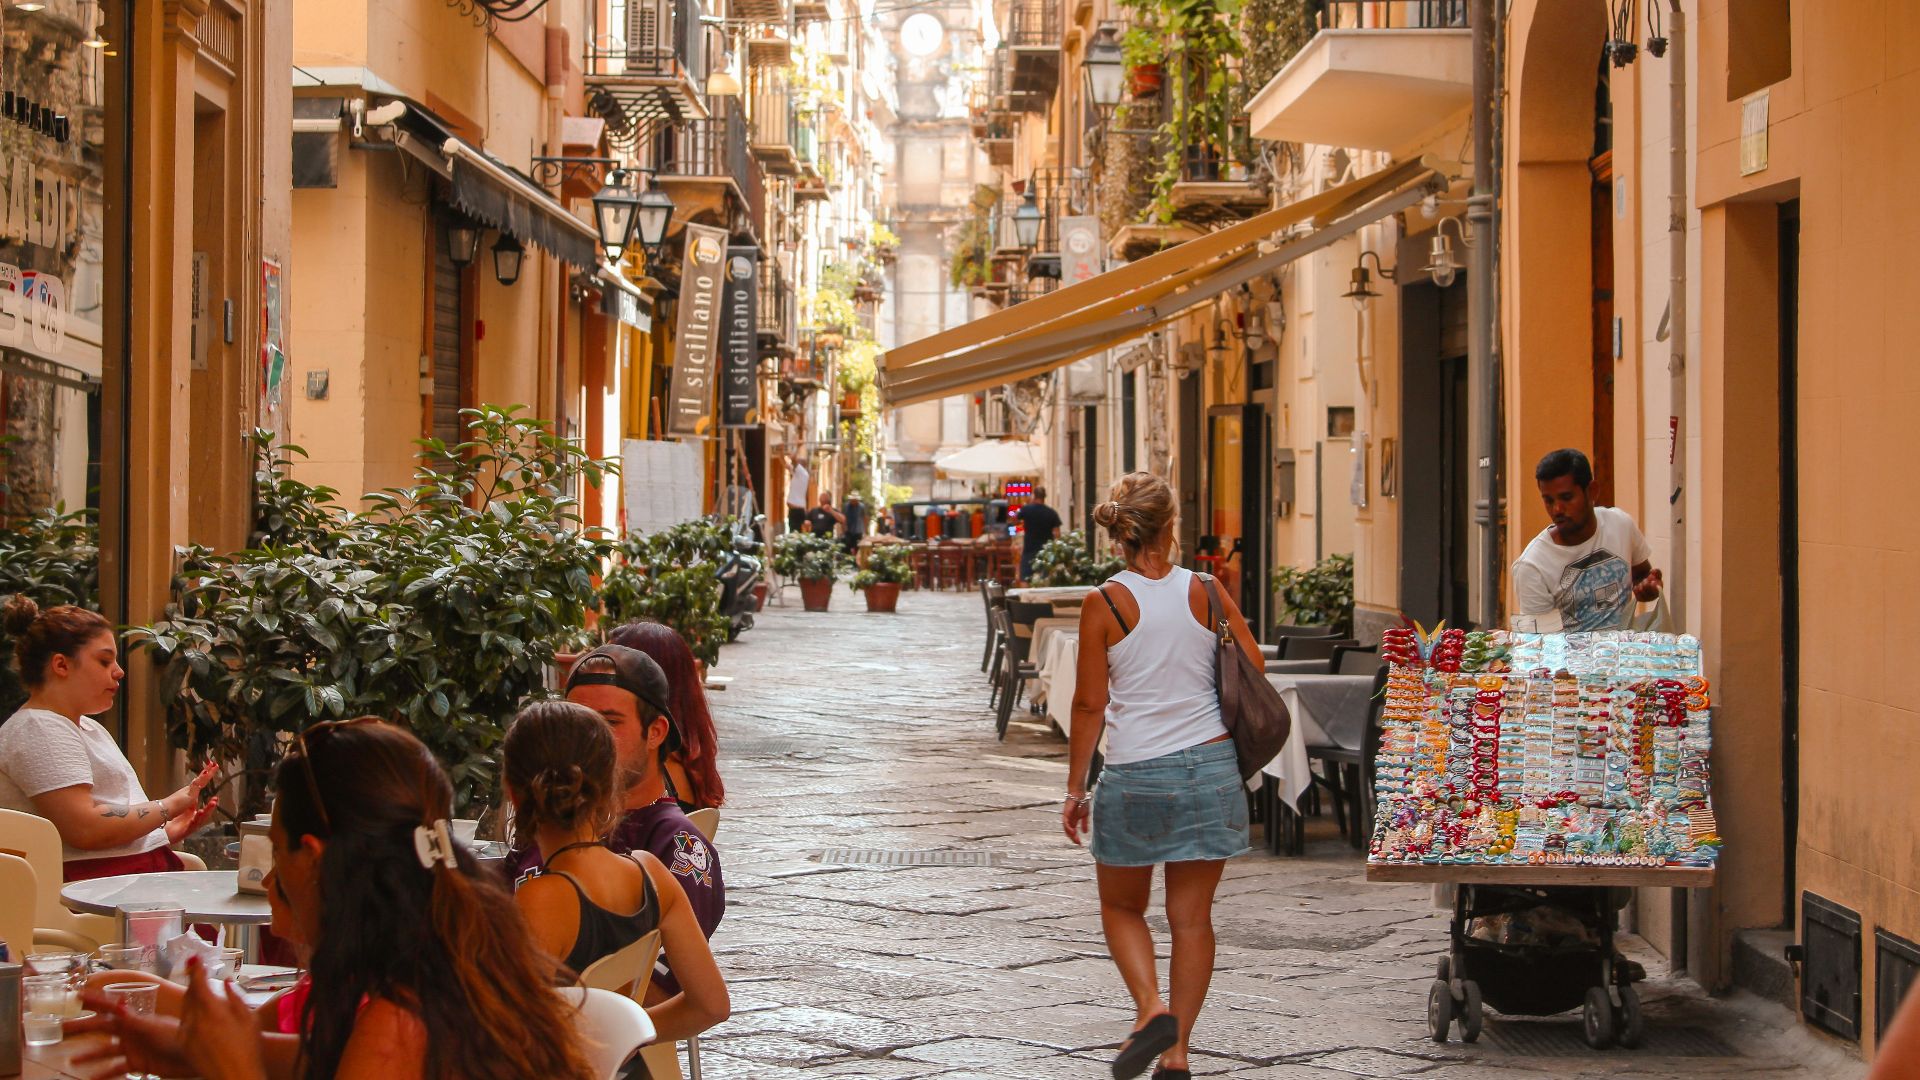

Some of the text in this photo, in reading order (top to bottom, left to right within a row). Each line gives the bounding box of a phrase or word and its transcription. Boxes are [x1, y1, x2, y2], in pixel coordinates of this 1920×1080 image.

[679, 275, 714, 414] il siciliano
[729, 289, 749, 408] il siciliano
